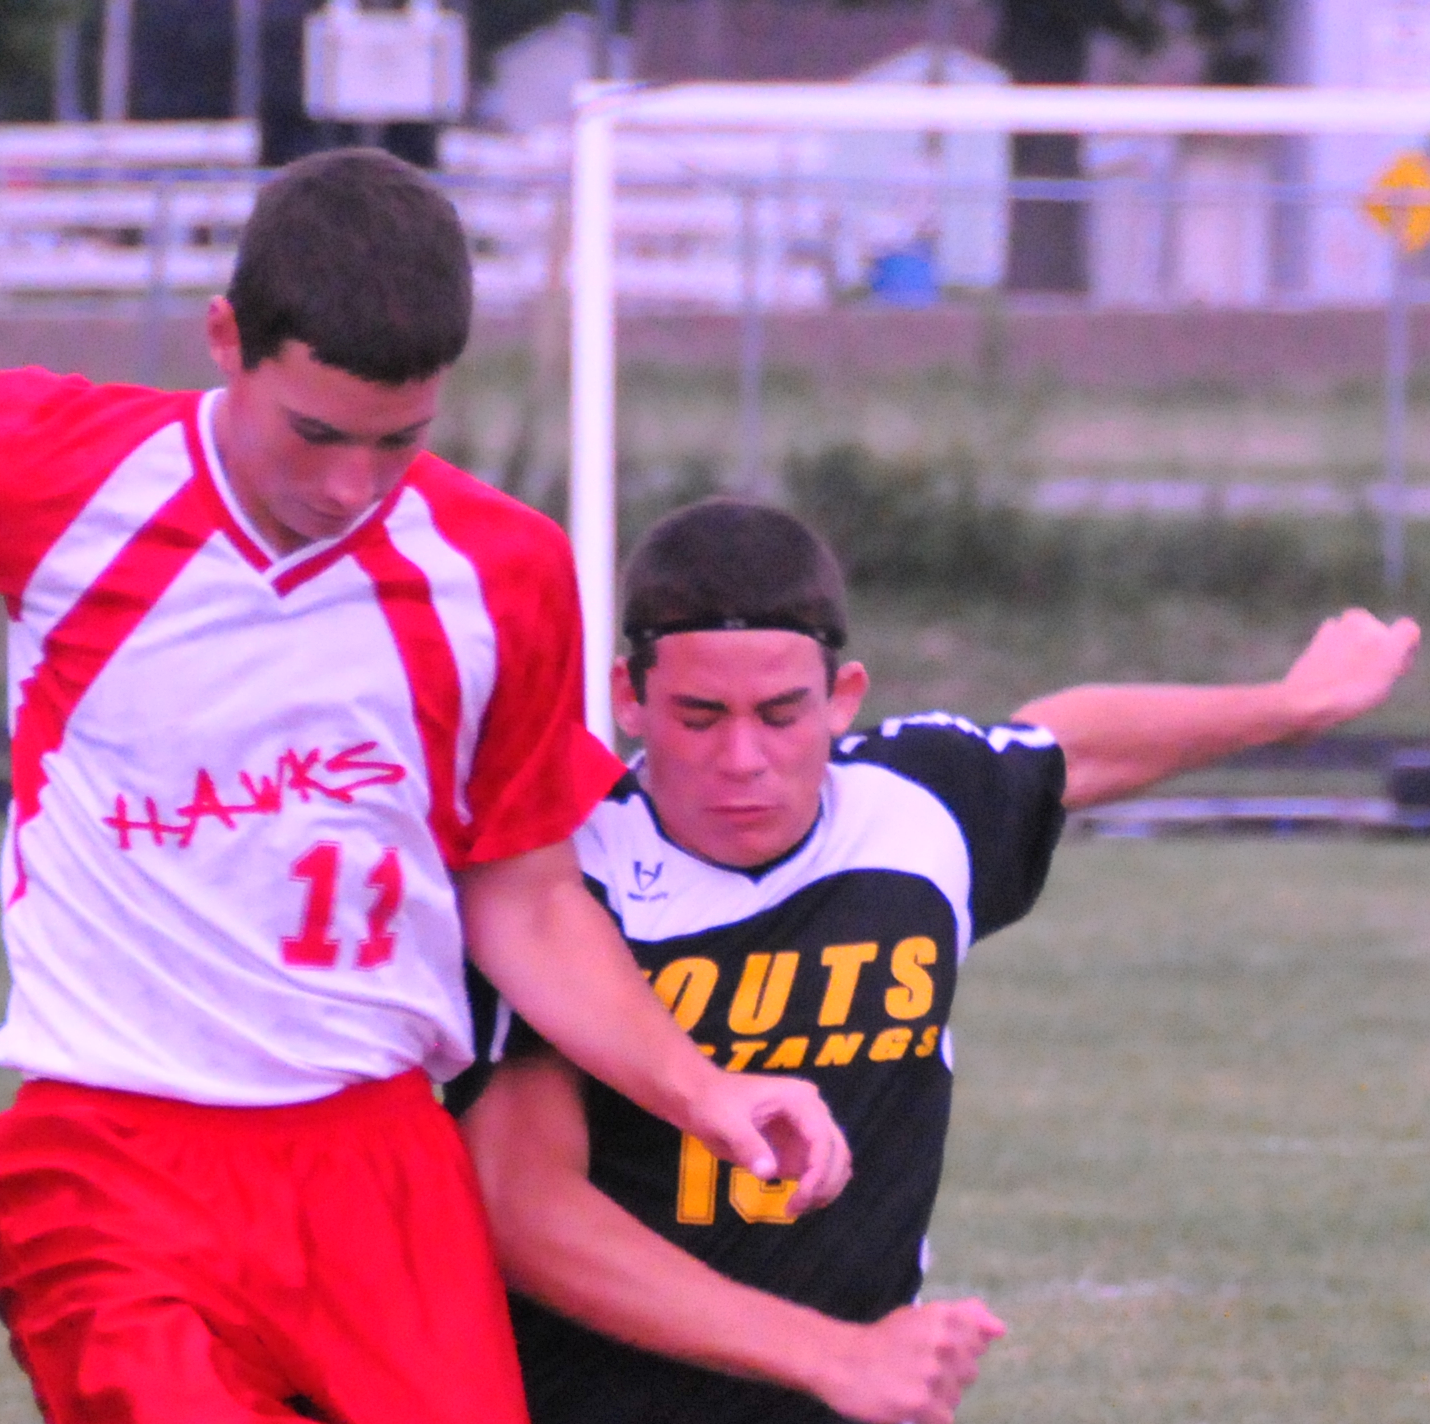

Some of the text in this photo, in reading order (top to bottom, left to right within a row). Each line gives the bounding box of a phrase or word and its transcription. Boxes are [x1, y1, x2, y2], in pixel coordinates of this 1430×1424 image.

[103, 741, 406, 849] HAWKS
[280, 840, 403, 969] 11
[642, 936, 938, 1036] OUTS
